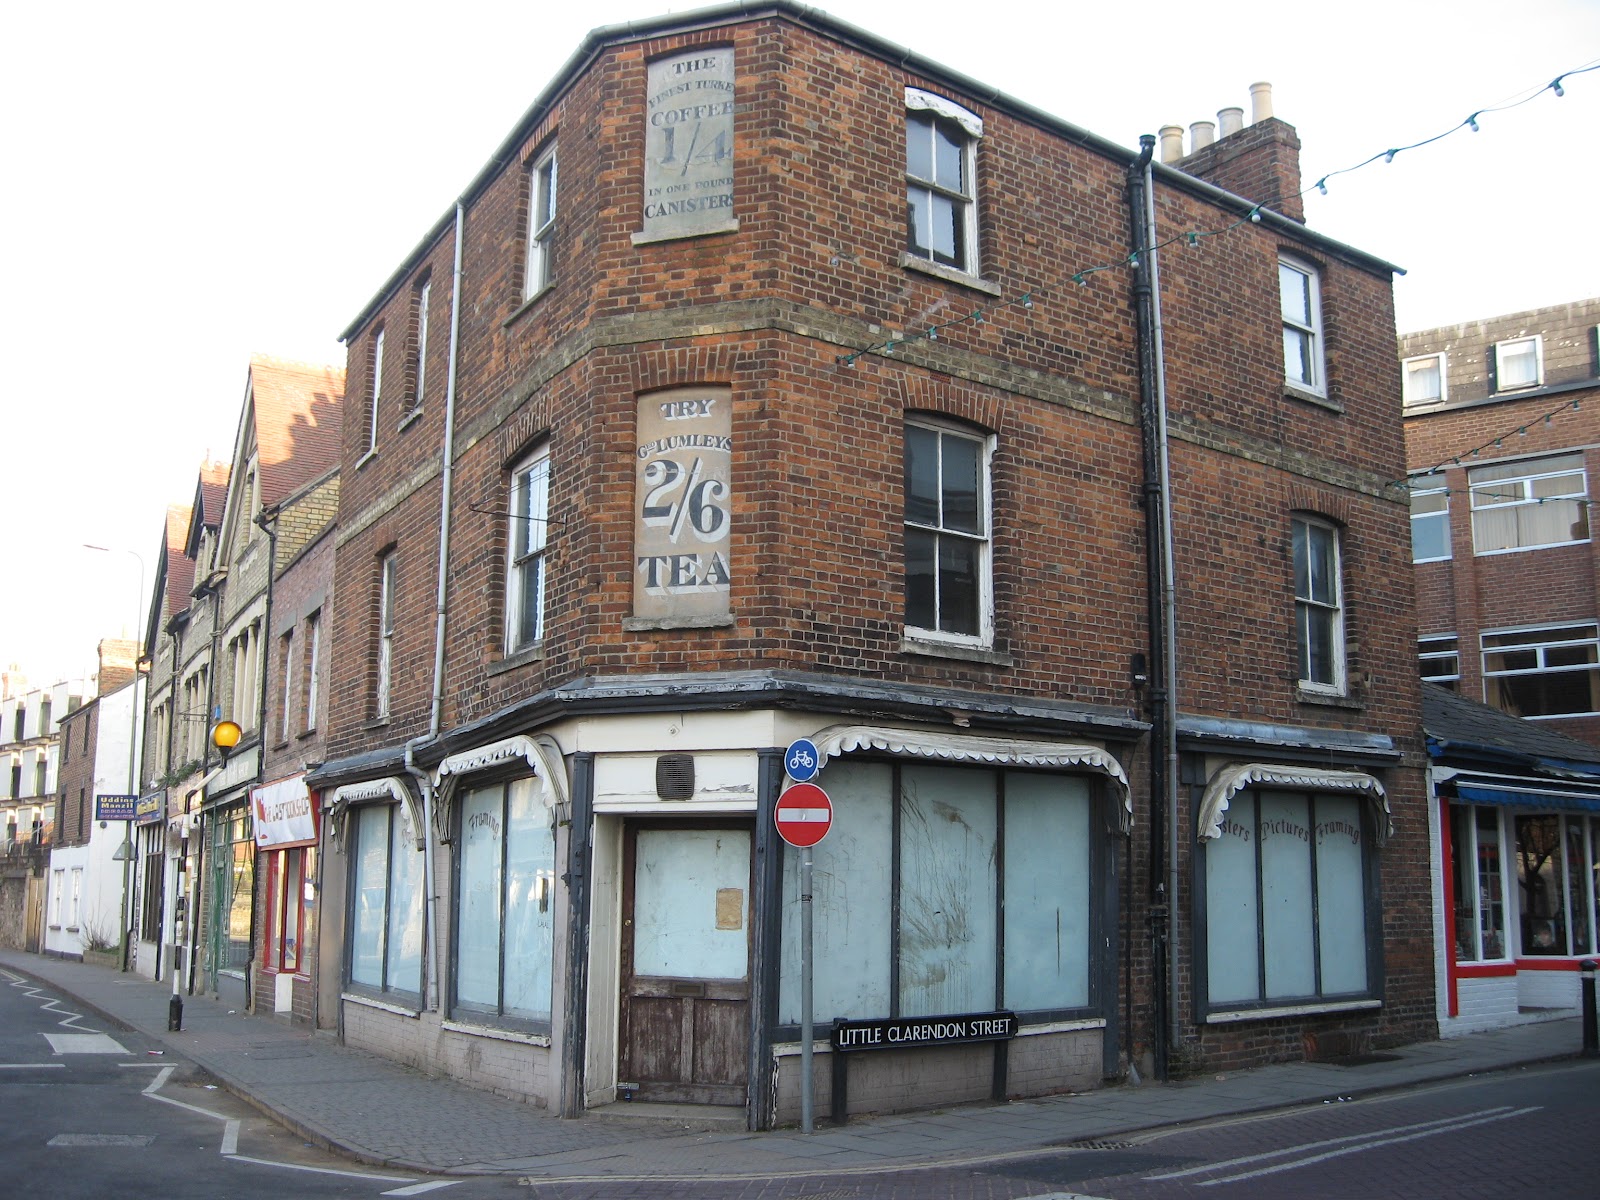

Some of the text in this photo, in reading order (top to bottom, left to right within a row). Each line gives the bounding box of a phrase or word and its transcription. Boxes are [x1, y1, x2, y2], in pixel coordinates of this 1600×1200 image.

[672, 57, 716, 74] THE
[648, 79, 735, 109] FINEST TURKE
[651, 102, 734, 127] COFFEE
[649, 178, 733, 196] IN ONE POUND
[660, 399, 716, 421] TRY
[641, 457, 730, 544] 2/6
[638, 551, 730, 595] TEA
[468, 811, 500, 840] Framing
[1219, 819, 1361, 845] sters Pictures Framing
[839, 1018, 1012, 1046] LITTLE CLARENDON STREET
